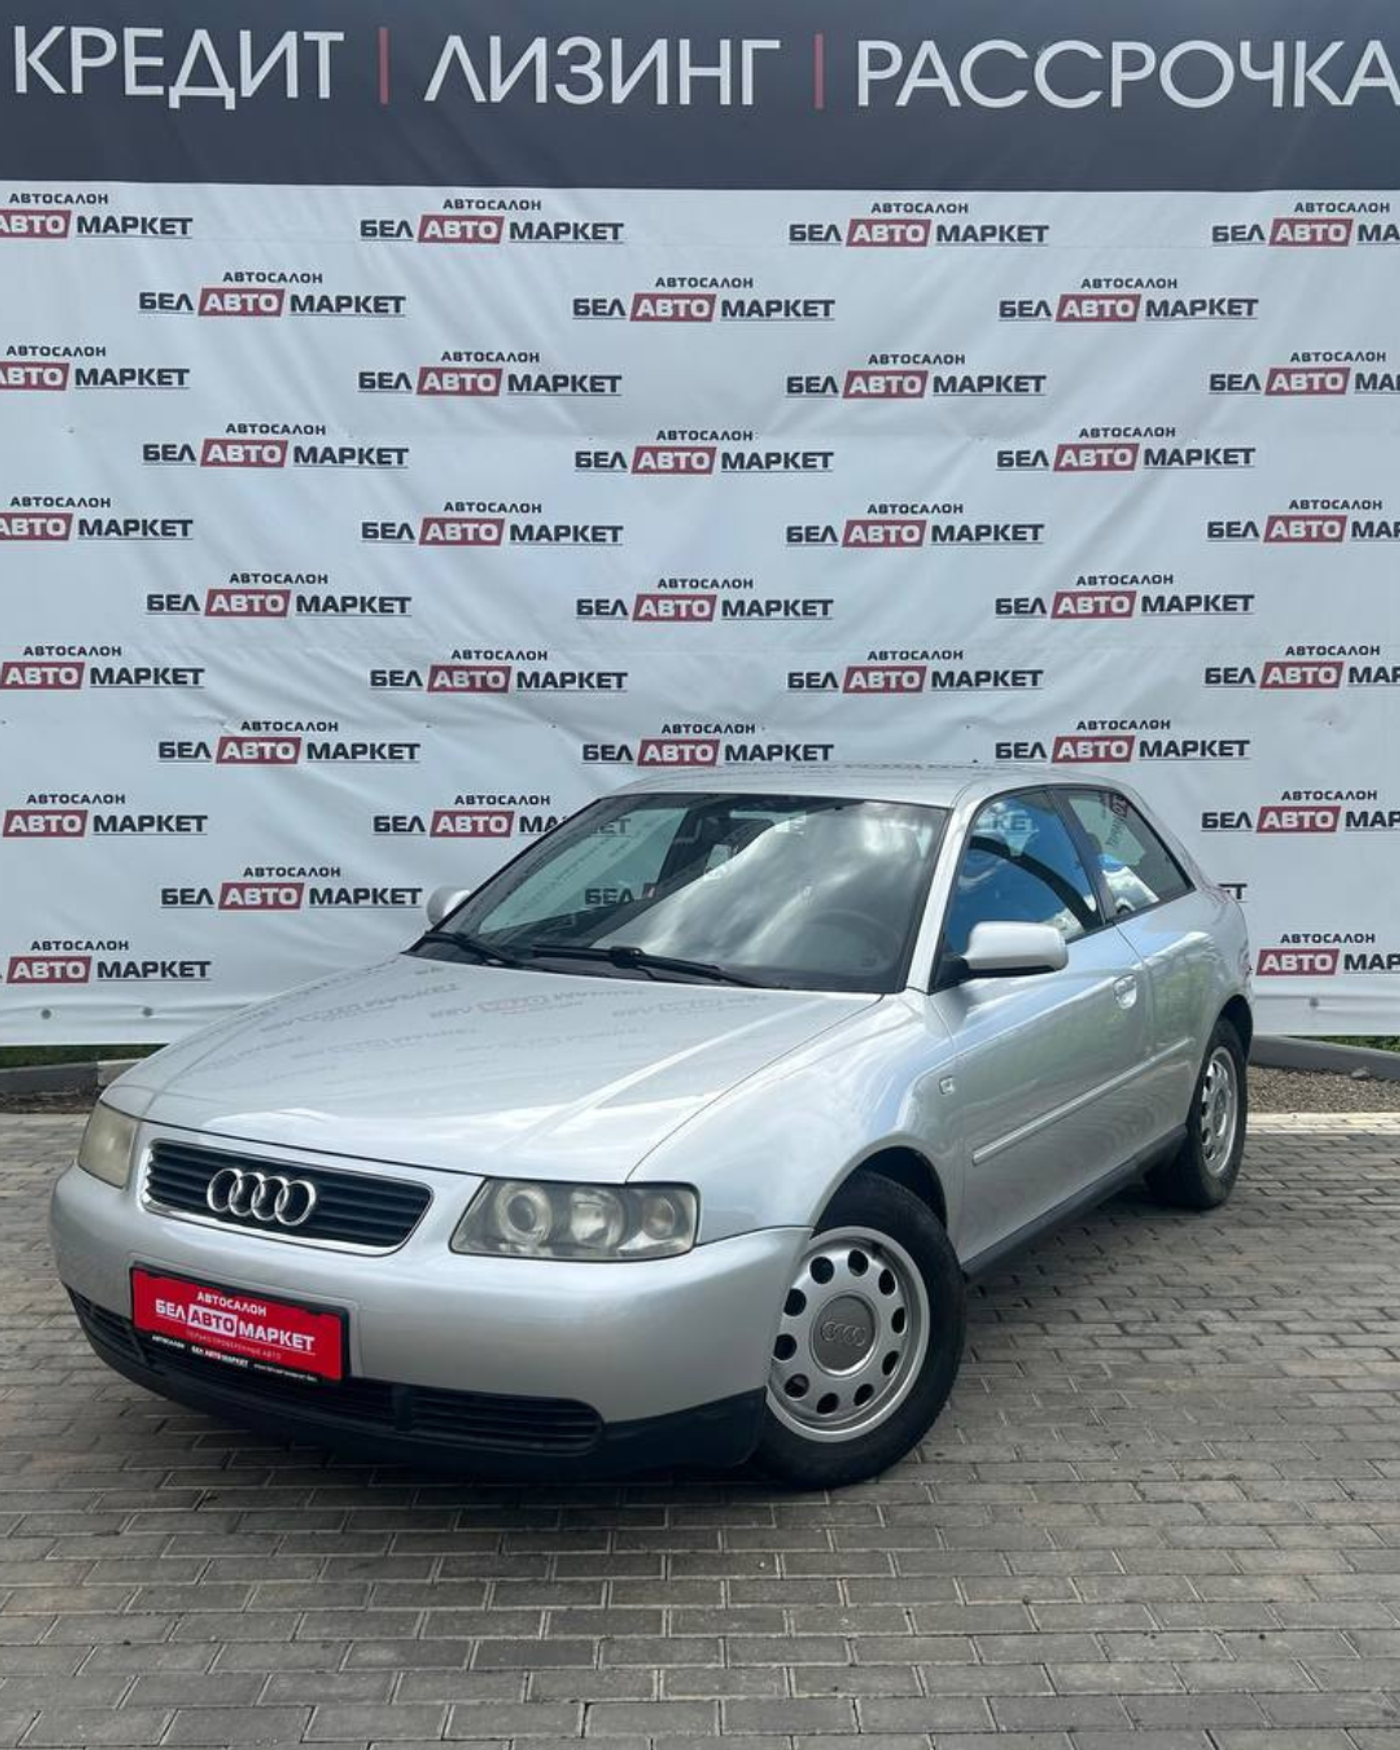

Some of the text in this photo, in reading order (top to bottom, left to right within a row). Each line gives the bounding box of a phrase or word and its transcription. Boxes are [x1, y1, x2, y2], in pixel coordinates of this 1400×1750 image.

[14, 25, 1400, 110] КРЕДИТ ЛИЗИНГ РАССРОЧКА
[9, 193, 109, 204] АВТОСАЛОН
[443, 199, 540, 210] АВТОСАЛОН
[872, 203, 968, 213] АВТОСАЛОН
[1295, 203, 1389, 212] АВТОСАЛОН
[77, 217, 193, 236] МАРКЕТ
[361, 220, 623, 240] БЕЛ АВТО МАРКЕТ
[790, 224, 1049, 242] БЕЛ АВТО МАРКЕТ
[1213, 225, 1265, 242] БЕЛ
[1278, 223, 1345, 242] АВТО
[223, 272, 322, 283] АВТОСАЛОН
[656, 278, 753, 288] АВТОСАЛОН
[1082, 279, 1177, 288] АВТОСАЛОН
[140, 292, 405, 313] БЕЛ АВТО МАРКЕТ
[574, 299, 835, 317] БЕЛ АВТО МАРКЕТ
[1000, 299, 1258, 317] БЕЛ АВТО МАРКЕТ
[6, 346, 106, 357] АВТОСАЛОН
[441, 352, 539, 362] АВТОСАЛОН
[869, 354, 965, 364] АВТОСАЛОН
[1289, 352, 1386, 362] АВТОСАЛОН
[75, 369, 190, 386] МАРКЕТ
[359, 372, 622, 391] БЕЛ АВТО МАРКЕТ
[787, 376, 1046, 394] БЕЛ АВТО МАРКЕТ
[1209, 372, 1400, 391] БЕЛ АВТО МА
[226, 424, 325, 435] АВТОСАЛОН
[657, 431, 752, 440] АВТОСАЛОН
[1079, 427, 1175, 437] АВТОСАЛОН
[143, 444, 408, 463] БЕЛ АВТО МАРКЕТ
[576, 452, 833, 469] БЕЛ АВТО МАРКЕТ
[998, 449, 1255, 467] БЕЛ АВТО МАРКЕТ
[11, 497, 111, 508] АВТОСАЛОН
[444, 502, 541, 513] АВТОСАЛОН
[868, 504, 963, 514] АВТОСАЛОН
[1289, 500, 1382, 509] АВТОСАЛОН
[78, 519, 193, 537] МАРКЕТ
[362, 522, 623, 541] БЕЛ АВТО МАРКЕТ
[787, 524, 1043, 543] БЕЛ АВТО МАРКЕТ
[1208, 521, 1259, 538] БЕЛ
[1270, 520, 1340, 538] АВТО
[230, 573, 327, 584] АВТОСАЛОН
[658, 579, 753, 589] АВТОСАЛОН
[1076, 575, 1173, 585] АВТОСАЛОН
[147, 594, 411, 613] БЕЛ АВТО МАРКЕТ
[577, 599, 833, 617] БЕЛ АВТО МАРКЕТ
[996, 595, 1254, 615] БЕЛ АВТО МАРКЕТ
[24, 646, 121, 656] АВТОСАЛОН
[451, 650, 548, 661] АВТОСАЛОН
[868, 651, 963, 660] АВТОСАЛОН
[1286, 646, 1379, 655] АВТОСАЛОН
[4, 666, 204, 685] АВТО МАРКЕТ
[370, 670, 628, 689] БЕЛ АВТО МАРКЕТ
[788, 670, 1043, 688] БЕЛ АВТО МАРКЕТ
[1205, 667, 1255, 684] БЕЛ
[1265, 667, 1336, 684] АВТО
[241, 721, 338, 731] АВТОСАЛОН
[662, 724, 755, 734] АВТОСАЛОН
[1077, 720, 1170, 730] АВТОСАЛОН
[159, 742, 420, 759] БЕЛ АВТО МАРКЕТ
[583, 744, 834, 761] БЕЛ АВТО МАРКЕТ
[996, 740, 1250, 759] БЕЛ АВТО МАРКЕТ
[27, 794, 125, 804] АВТОСАЛОН
[455, 795, 550, 805] АВТОСАЛОН
[1282, 791, 1377, 800] АВТОСАЛОН
[7, 814, 207, 833] АВТО МАРКЕТ
[374, 816, 426, 833] БЕЛ
[439, 816, 506, 833] АВТО
[1202, 812, 1252, 828] БЕЛ
[1263, 811, 1332, 828] АВТО
[244, 867, 340, 877] АВТОСАЛОН
[162, 888, 422, 905] БЕЛ АВТО МАРКЕТ
[585, 888, 634, 904] БЕЛ
[31, 941, 129, 950] АВТОСАЛОН
[1281, 934, 1375, 943] АВТОСАЛОН
[12, 961, 211, 979] АВТО МАРКЕТ
[1264, 954, 1400, 971] АВТО МАР
[197, 1291, 267, 1317] АВТОСАЛОН
[155, 1299, 315, 1351] БЕЛ АВТО МАРКЕТ
